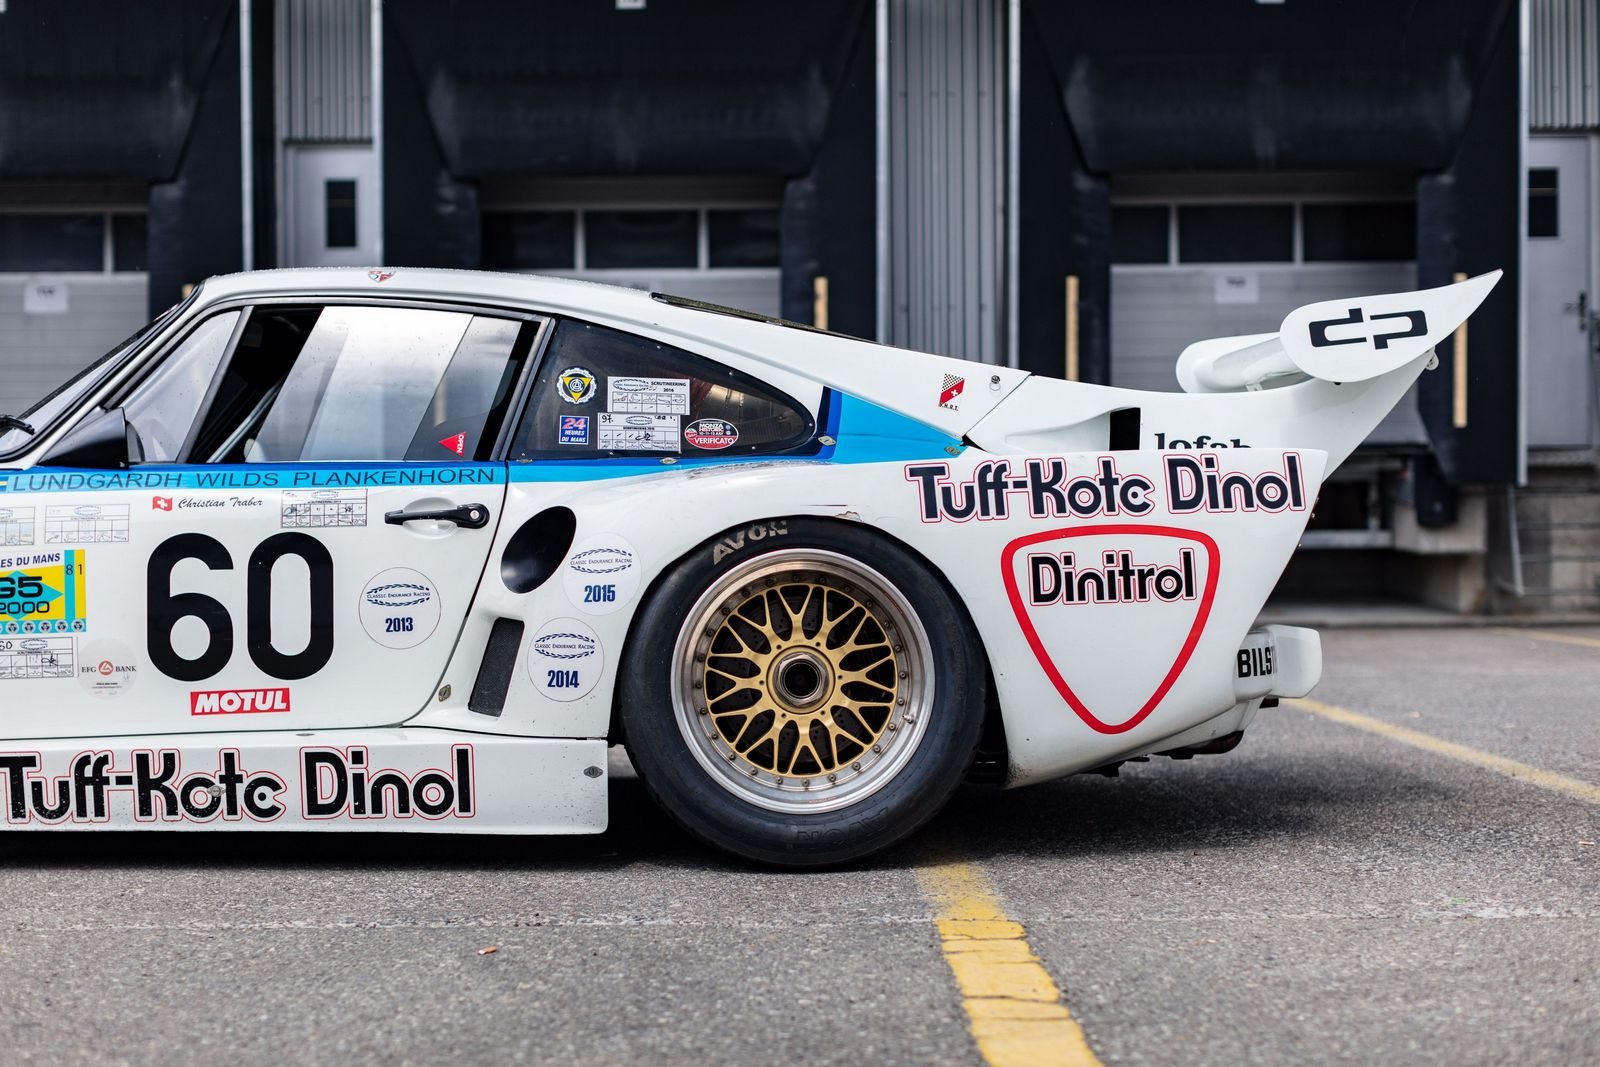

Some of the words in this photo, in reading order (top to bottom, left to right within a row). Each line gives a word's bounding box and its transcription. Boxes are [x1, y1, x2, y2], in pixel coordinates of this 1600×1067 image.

[561, 417, 586, 430] 24
[456, 434, 465, 454] OPEN
[13, 473, 182, 491] LUNDGARDH
[197, 471, 279, 487] WILDS
[293, 468, 495, 487] PLANKENHORN
[905, 456, 1154, 523] Tuff-Kote
[1163, 452, 1306, 514] Dinol
[178, 497, 226, 509] Christian
[229, 496, 263, 508] Traber
[712, 519, 788, 566] AVON
[16, 556, 30, 566] DU
[33, 552, 61, 565] MANS
[1028, 548, 1197, 606] Dinitrol
[583, 584, 616, 603] 2015
[147, 532, 333, 681] 60
[385, 616, 414, 633] 2013
[547, 669, 580, 688] 2014
[194, 690, 287, 713] MOTUL
[299, 744, 475, 821] Dinol
